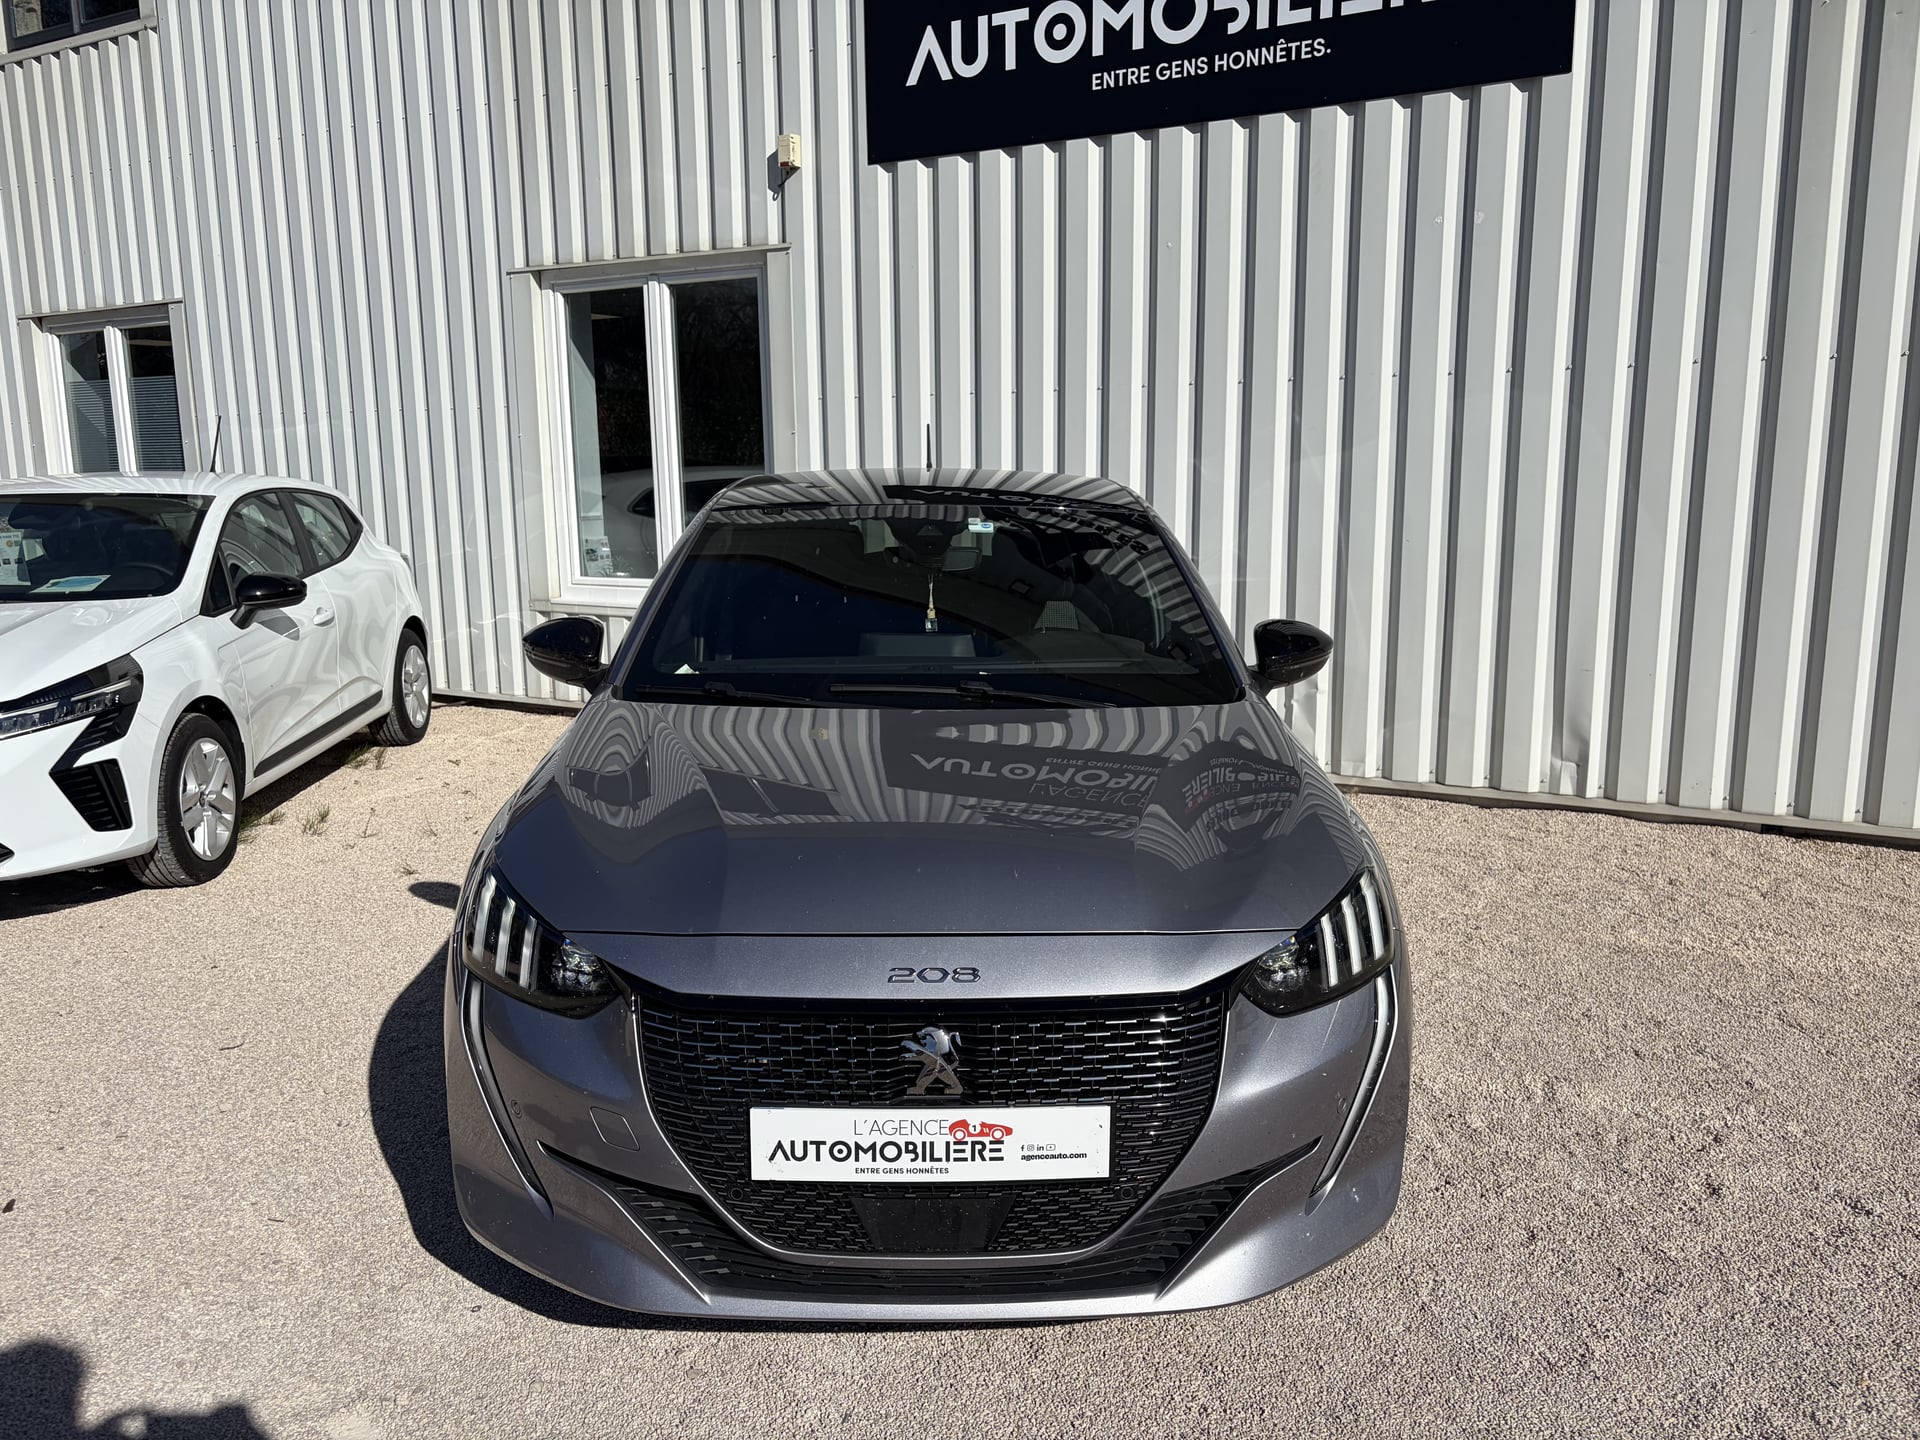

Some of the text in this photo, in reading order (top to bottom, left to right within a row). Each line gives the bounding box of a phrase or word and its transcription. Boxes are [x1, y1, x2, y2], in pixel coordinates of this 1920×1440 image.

[905, 0, 1437, 87] AUTOMOB
[1092, 38, 1331, 90] ENTRE GENS HONNÊTES.
[887, 967, 981, 983] 208
[854, 1119, 949, 1136] L'AGENCE
[1020, 1152, 1088, 1161] agenceauto.com
[882, 1167, 905, 1175] GENS
[906, 1165, 949, 1175] HONNÊTES
